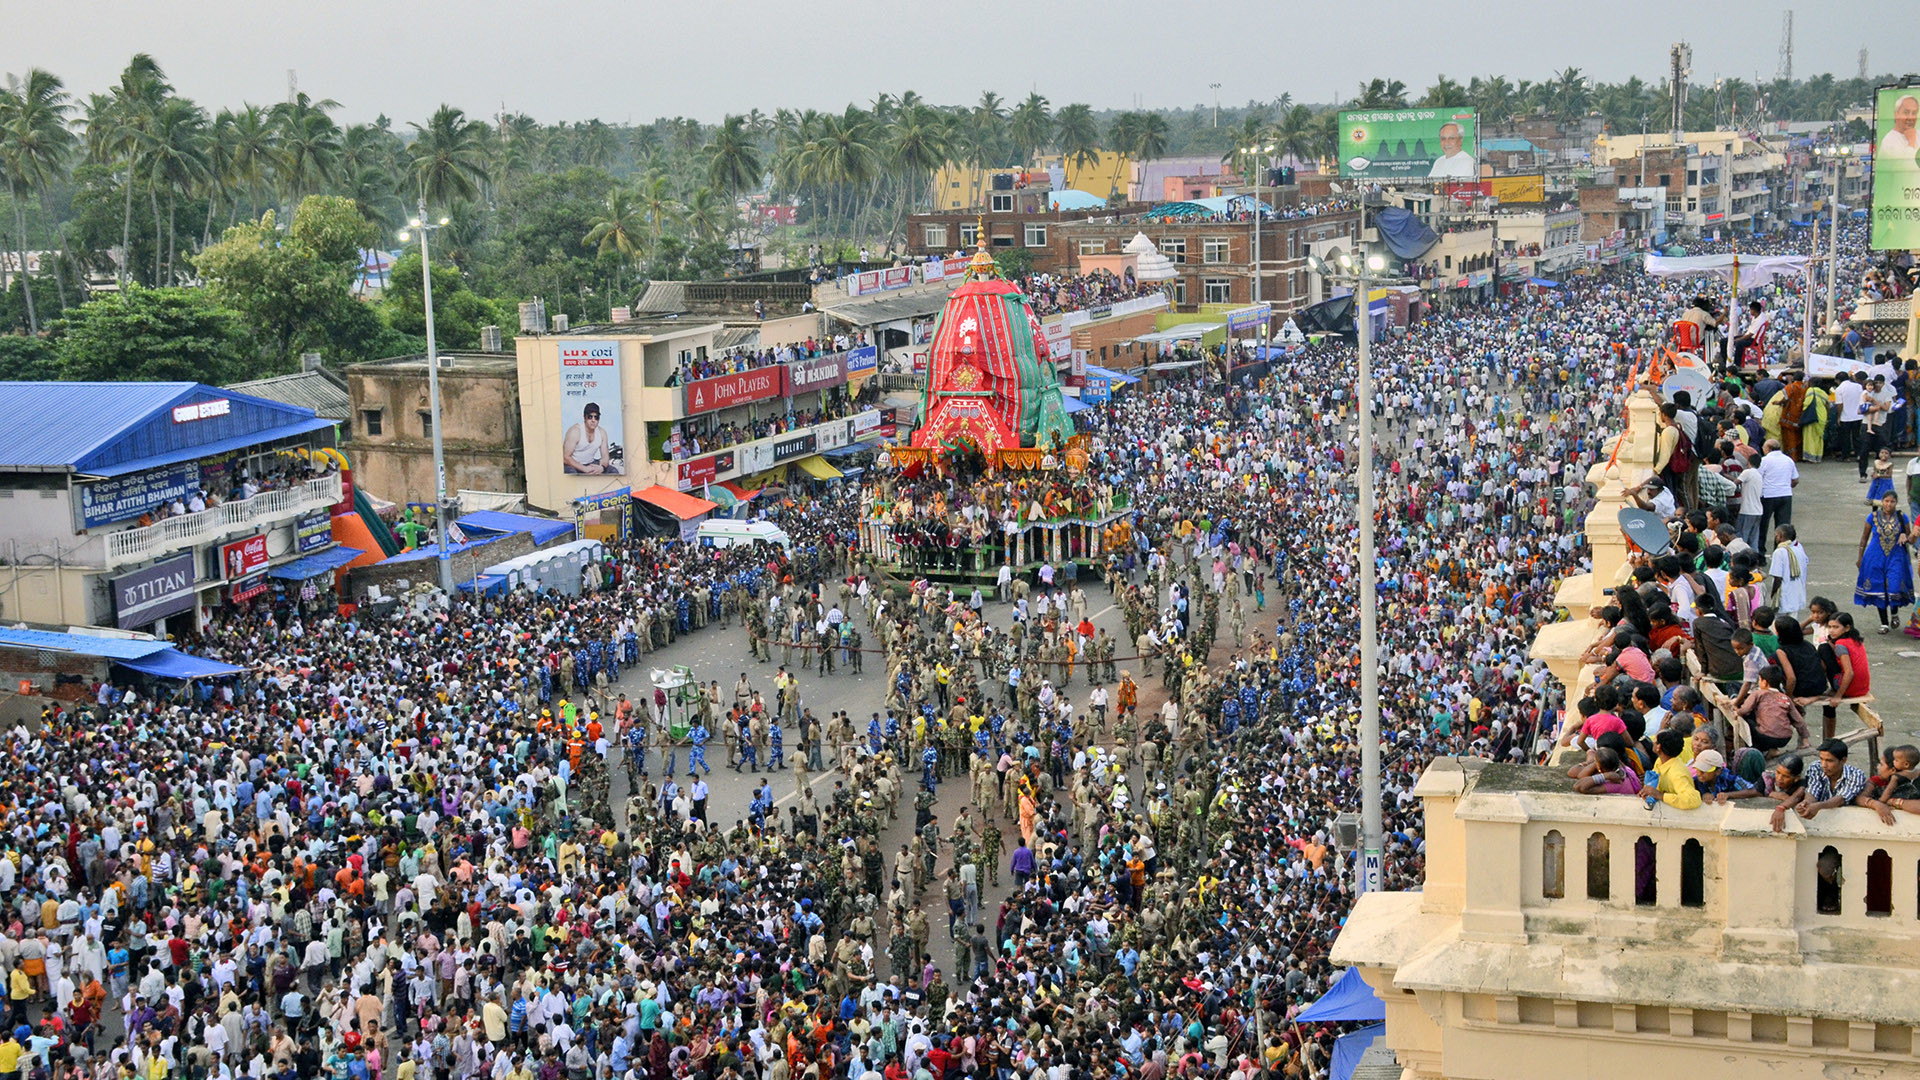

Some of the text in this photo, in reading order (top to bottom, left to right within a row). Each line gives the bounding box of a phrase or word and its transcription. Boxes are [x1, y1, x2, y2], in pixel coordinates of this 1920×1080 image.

[563, 349, 588, 357] LUX
[776, 440, 804, 456] PROLINE
[85, 501, 114, 518] BIHAR
[116, 493, 146, 511] ATITHI
[147, 484, 185, 503] BHAWAN
[137, 570, 186, 600] TITAN
